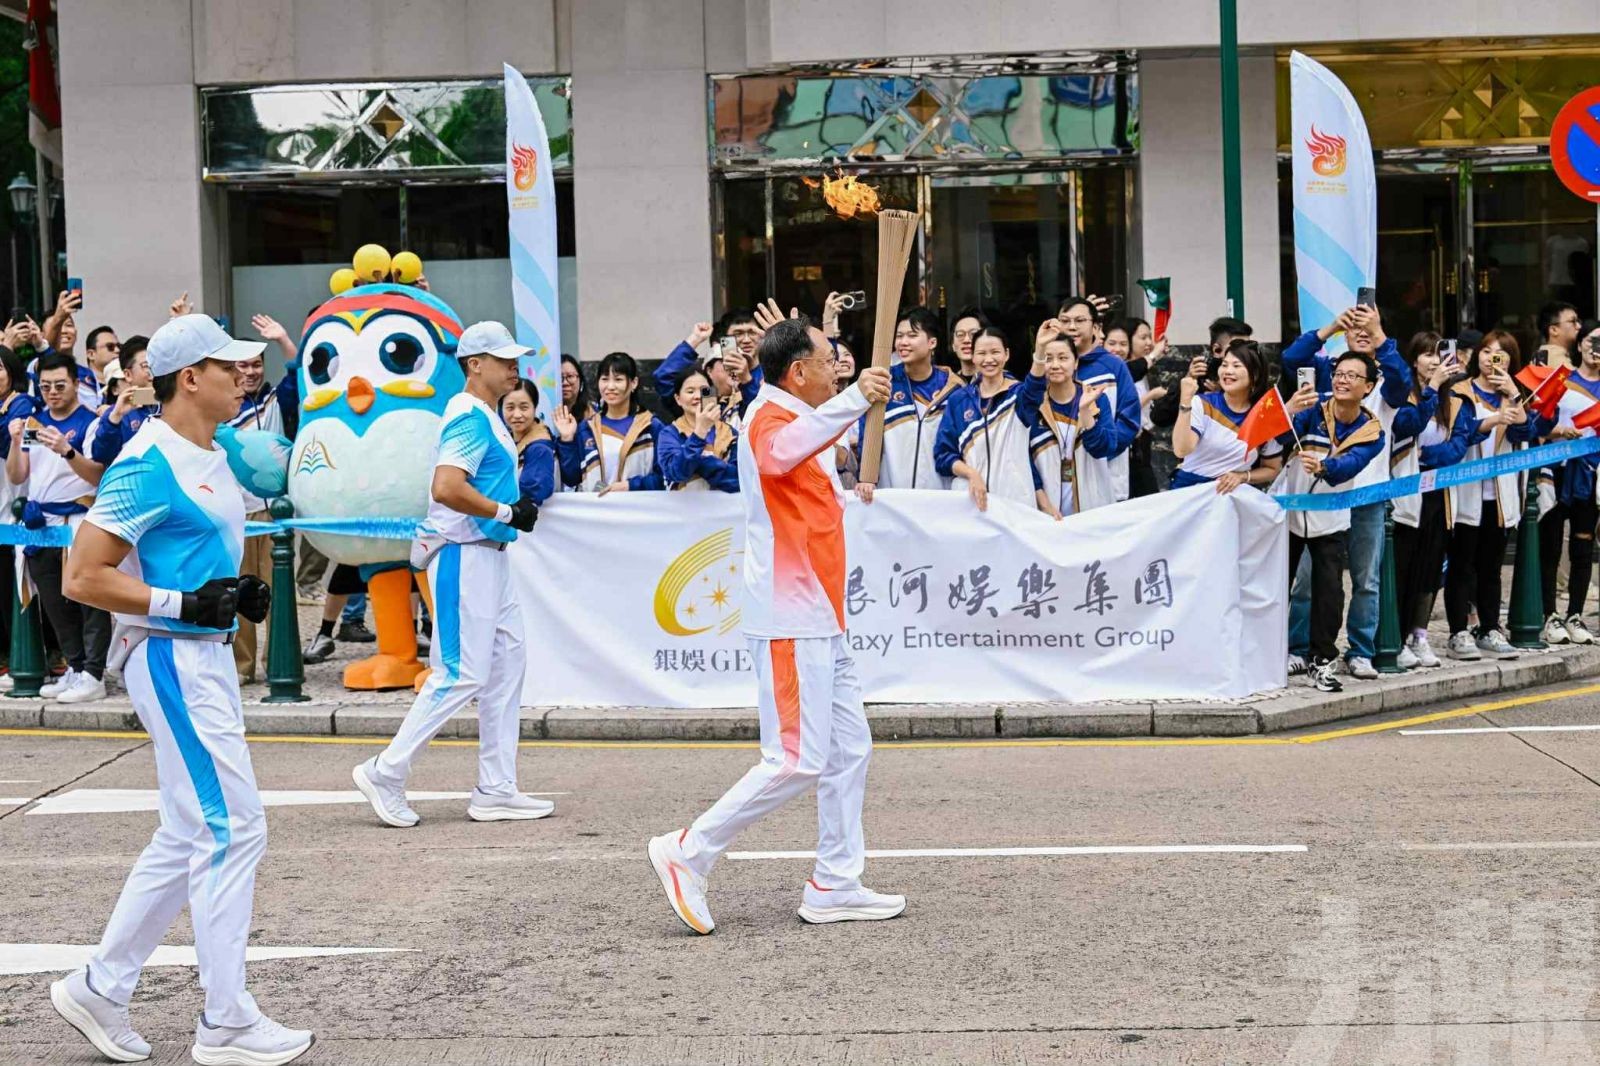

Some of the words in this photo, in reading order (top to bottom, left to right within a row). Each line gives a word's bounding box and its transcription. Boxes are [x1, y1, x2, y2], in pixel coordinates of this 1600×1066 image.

[846, 628, 893, 657] laxy
[904, 626, 1085, 648] Entertainment
[1094, 626, 1175, 651] Group
[711, 649, 752, 672] GE
